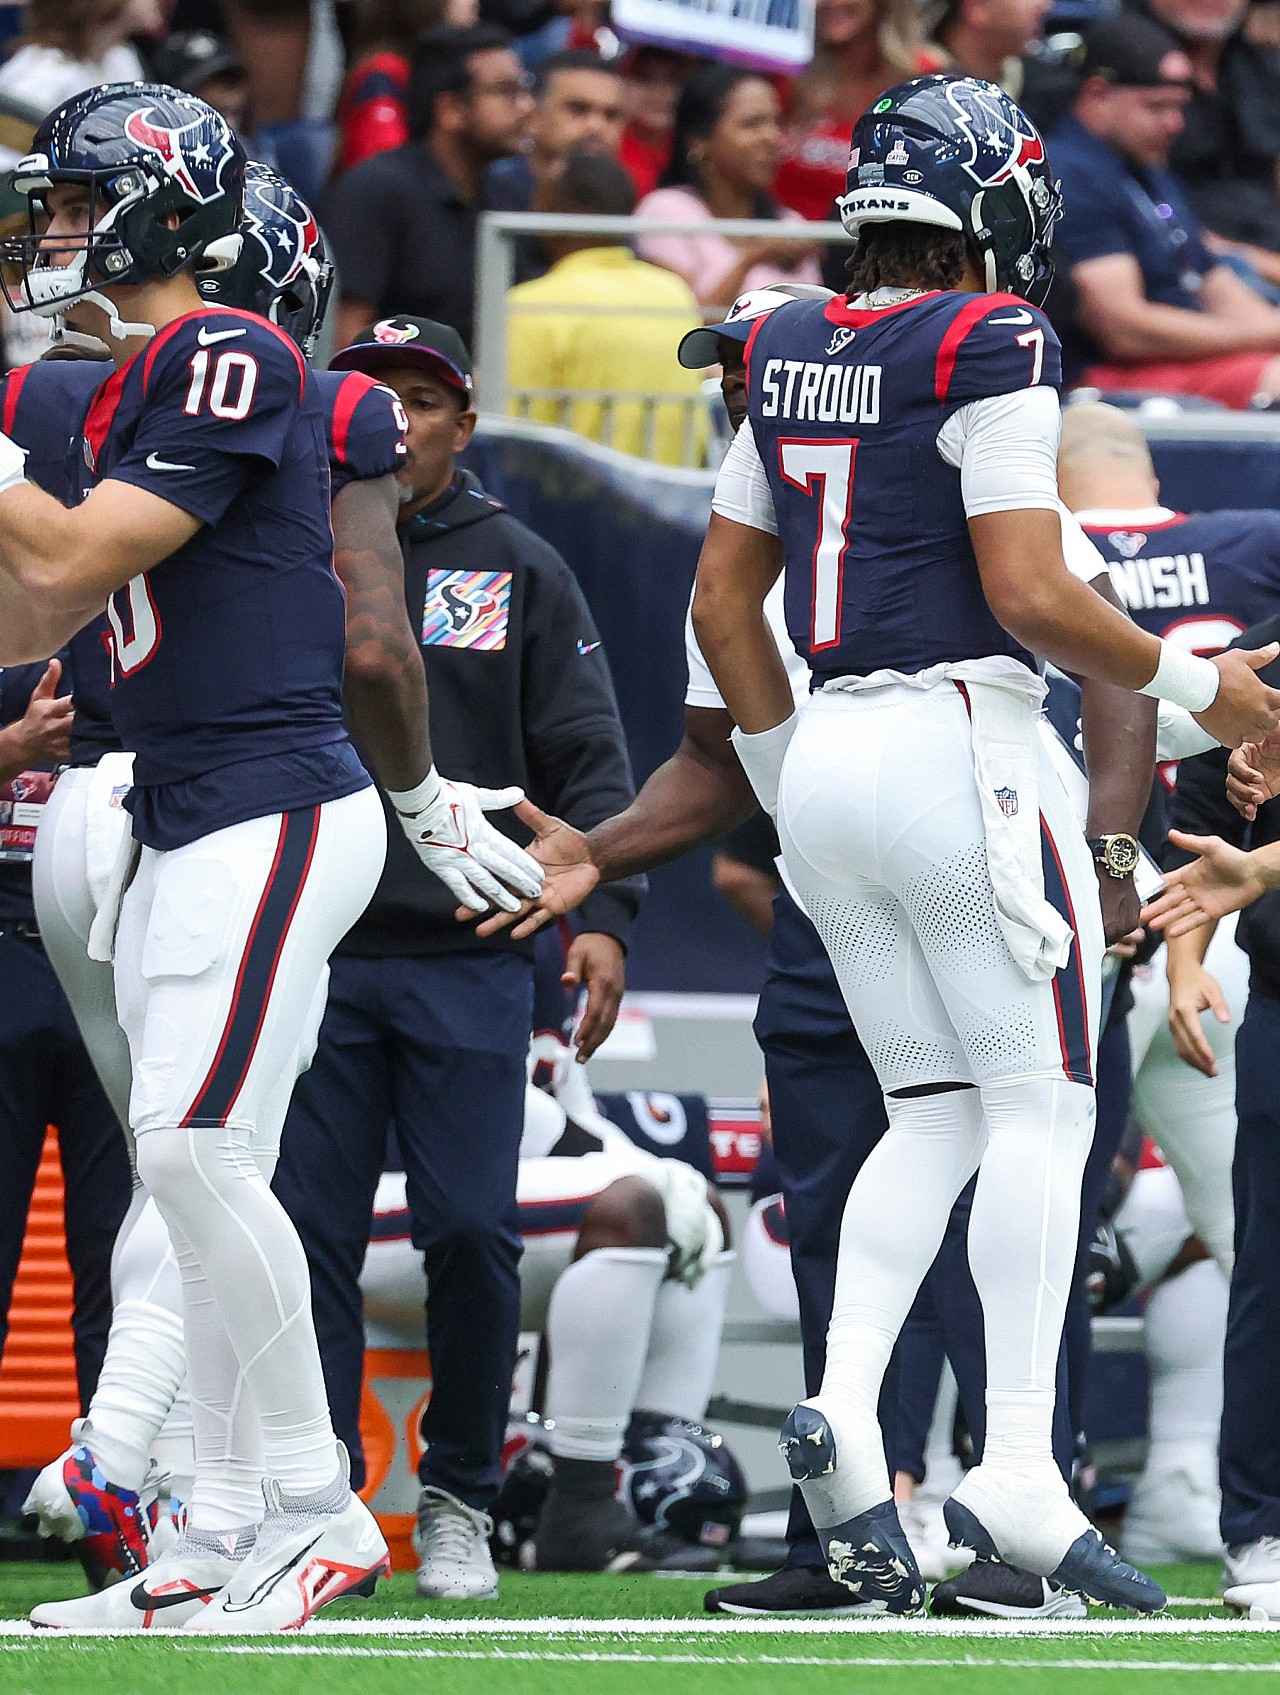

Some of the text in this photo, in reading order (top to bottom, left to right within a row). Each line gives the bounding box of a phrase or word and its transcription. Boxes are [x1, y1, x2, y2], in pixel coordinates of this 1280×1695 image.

[841, 199, 910, 216] TEXANS
[182, 349, 260, 421] 10
[1014, 326, 1045, 387] 7
[762, 358, 882, 424] STROUD
[778, 437, 859, 654] 7
